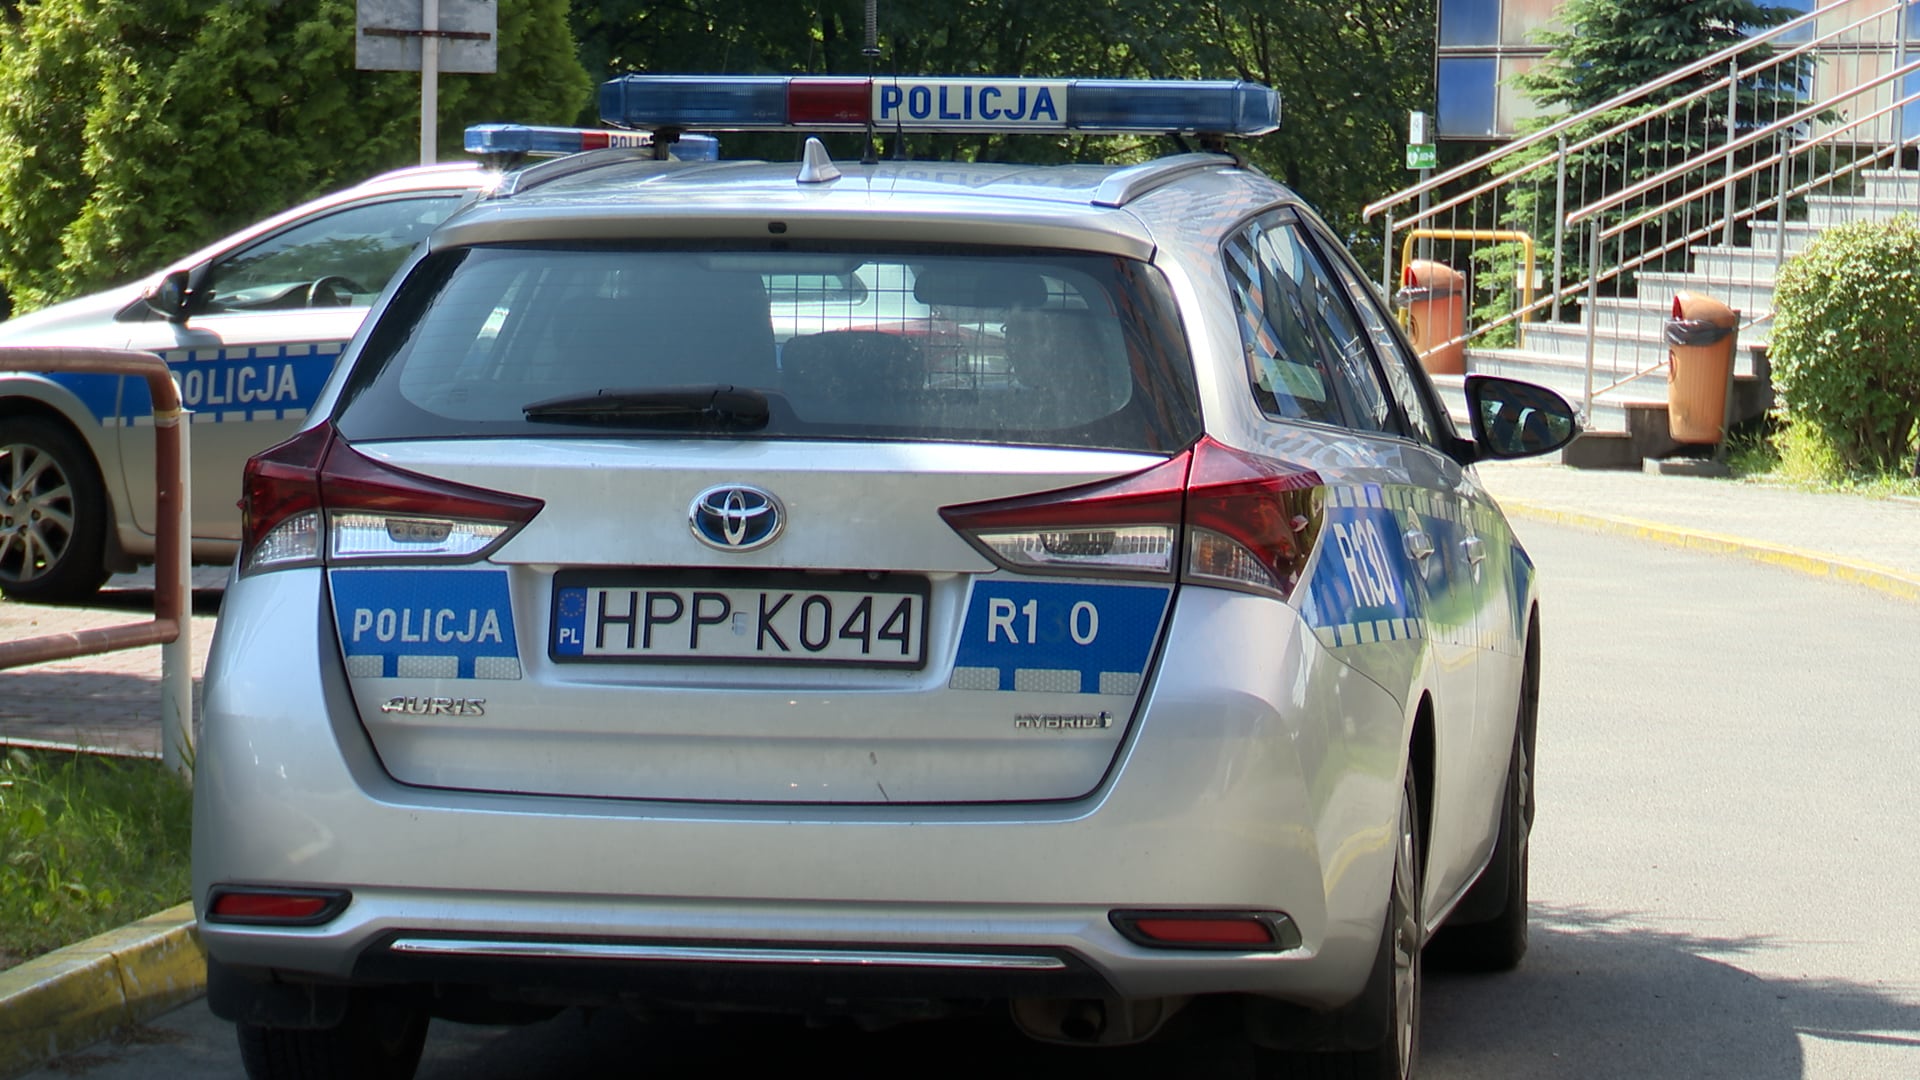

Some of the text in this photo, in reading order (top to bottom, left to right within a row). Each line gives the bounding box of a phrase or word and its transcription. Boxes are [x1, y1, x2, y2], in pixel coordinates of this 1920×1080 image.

[880, 85, 1059, 121] POLICJA
[1332, 518, 1397, 608] R130
[353, 607, 503, 643] POLICJA
[558, 628, 580, 645] PL
[595, 591, 912, 655] HPP K044
[380, 695, 486, 717] AURIS
[1014, 712, 1097, 729] HYBRID
